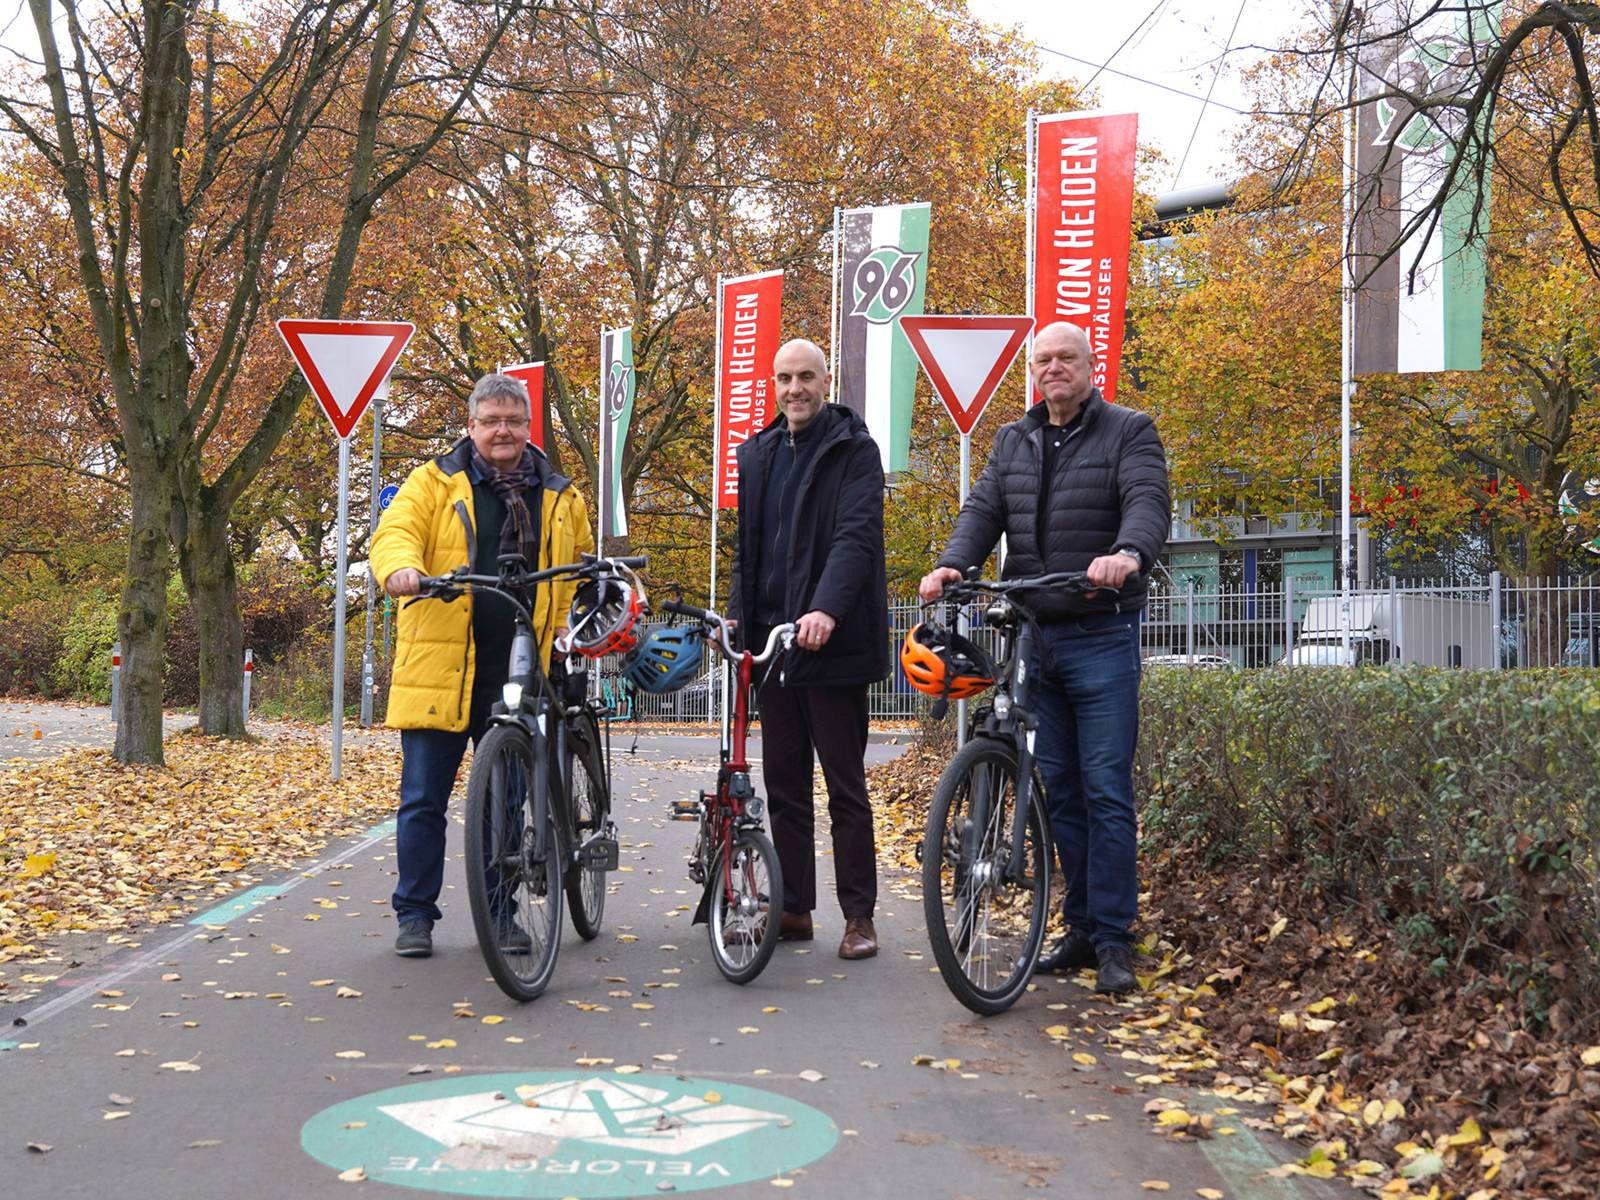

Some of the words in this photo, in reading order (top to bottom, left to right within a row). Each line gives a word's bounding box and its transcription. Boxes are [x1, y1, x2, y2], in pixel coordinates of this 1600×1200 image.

[1053, 136, 1098, 248] HEIDEN
[849, 253, 919, 317] 96
[1055, 258, 1092, 316] VON
[729, 293, 759, 374] HEIDEN
[728, 380, 753, 424] VON
[387, 1155, 731, 1177] VELOROTE
